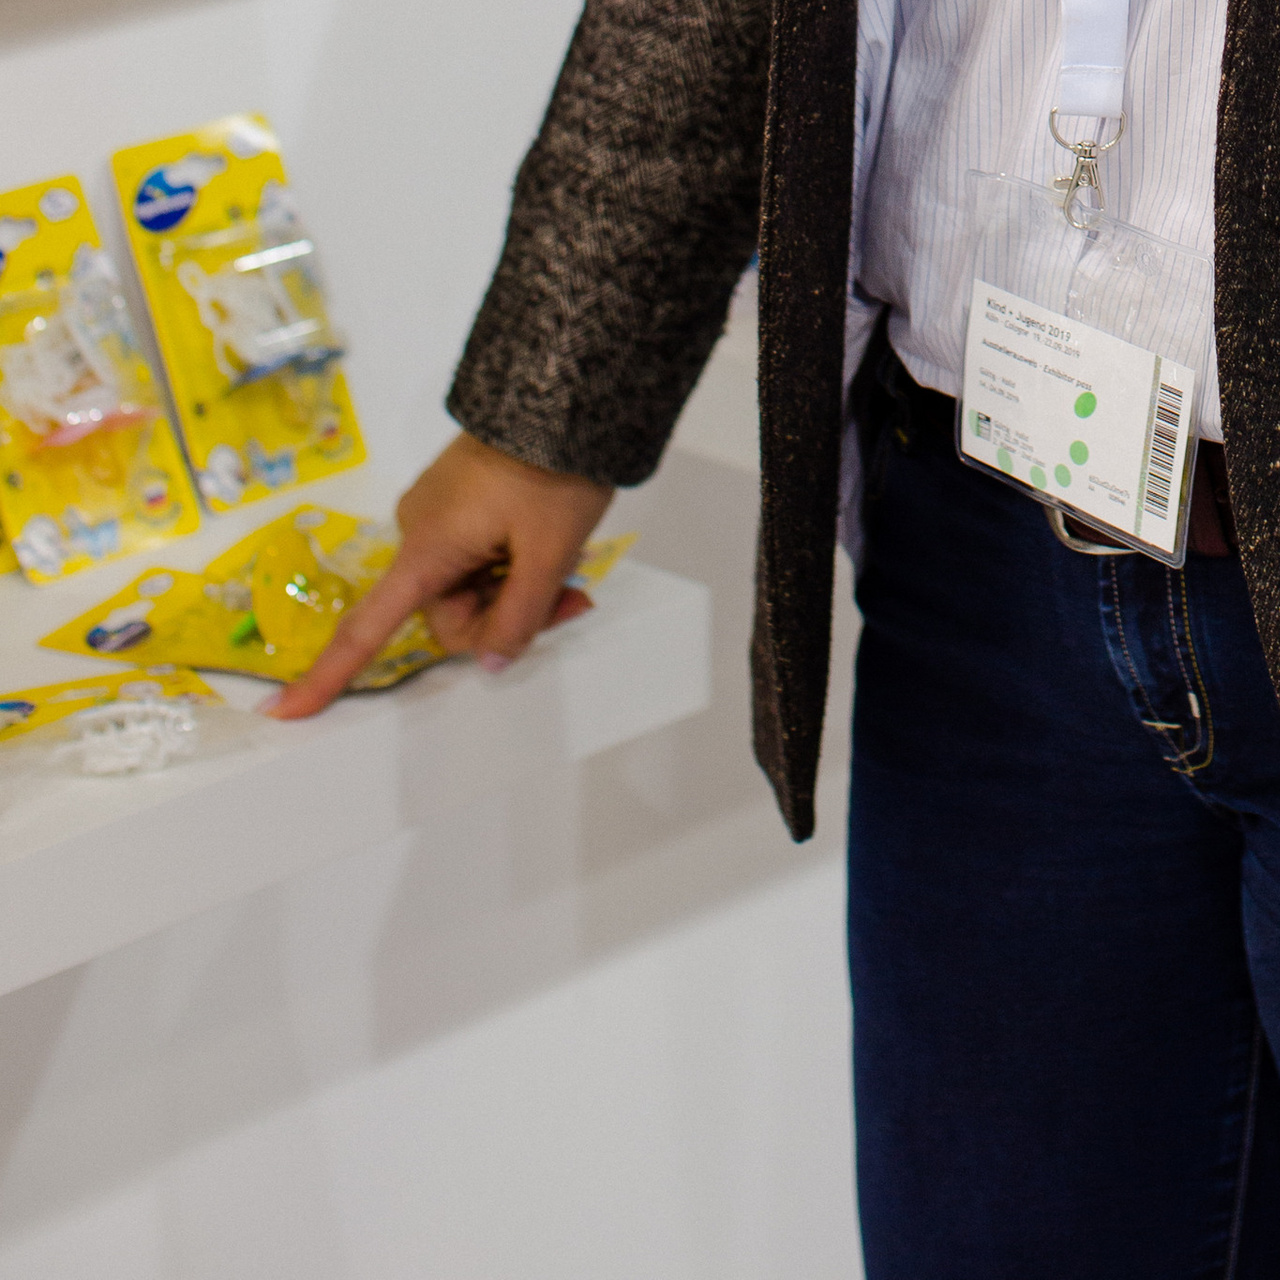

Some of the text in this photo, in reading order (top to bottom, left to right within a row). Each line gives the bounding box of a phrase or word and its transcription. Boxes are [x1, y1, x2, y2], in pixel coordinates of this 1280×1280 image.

[986, 297, 1007, 314] Kind
[1015, 311, 1047, 333] Jugend
[1048, 324, 1072, 342] 2019
[1043, 364, 1075, 384] Exhibitor
[1075, 380, 1092, 391] pass
